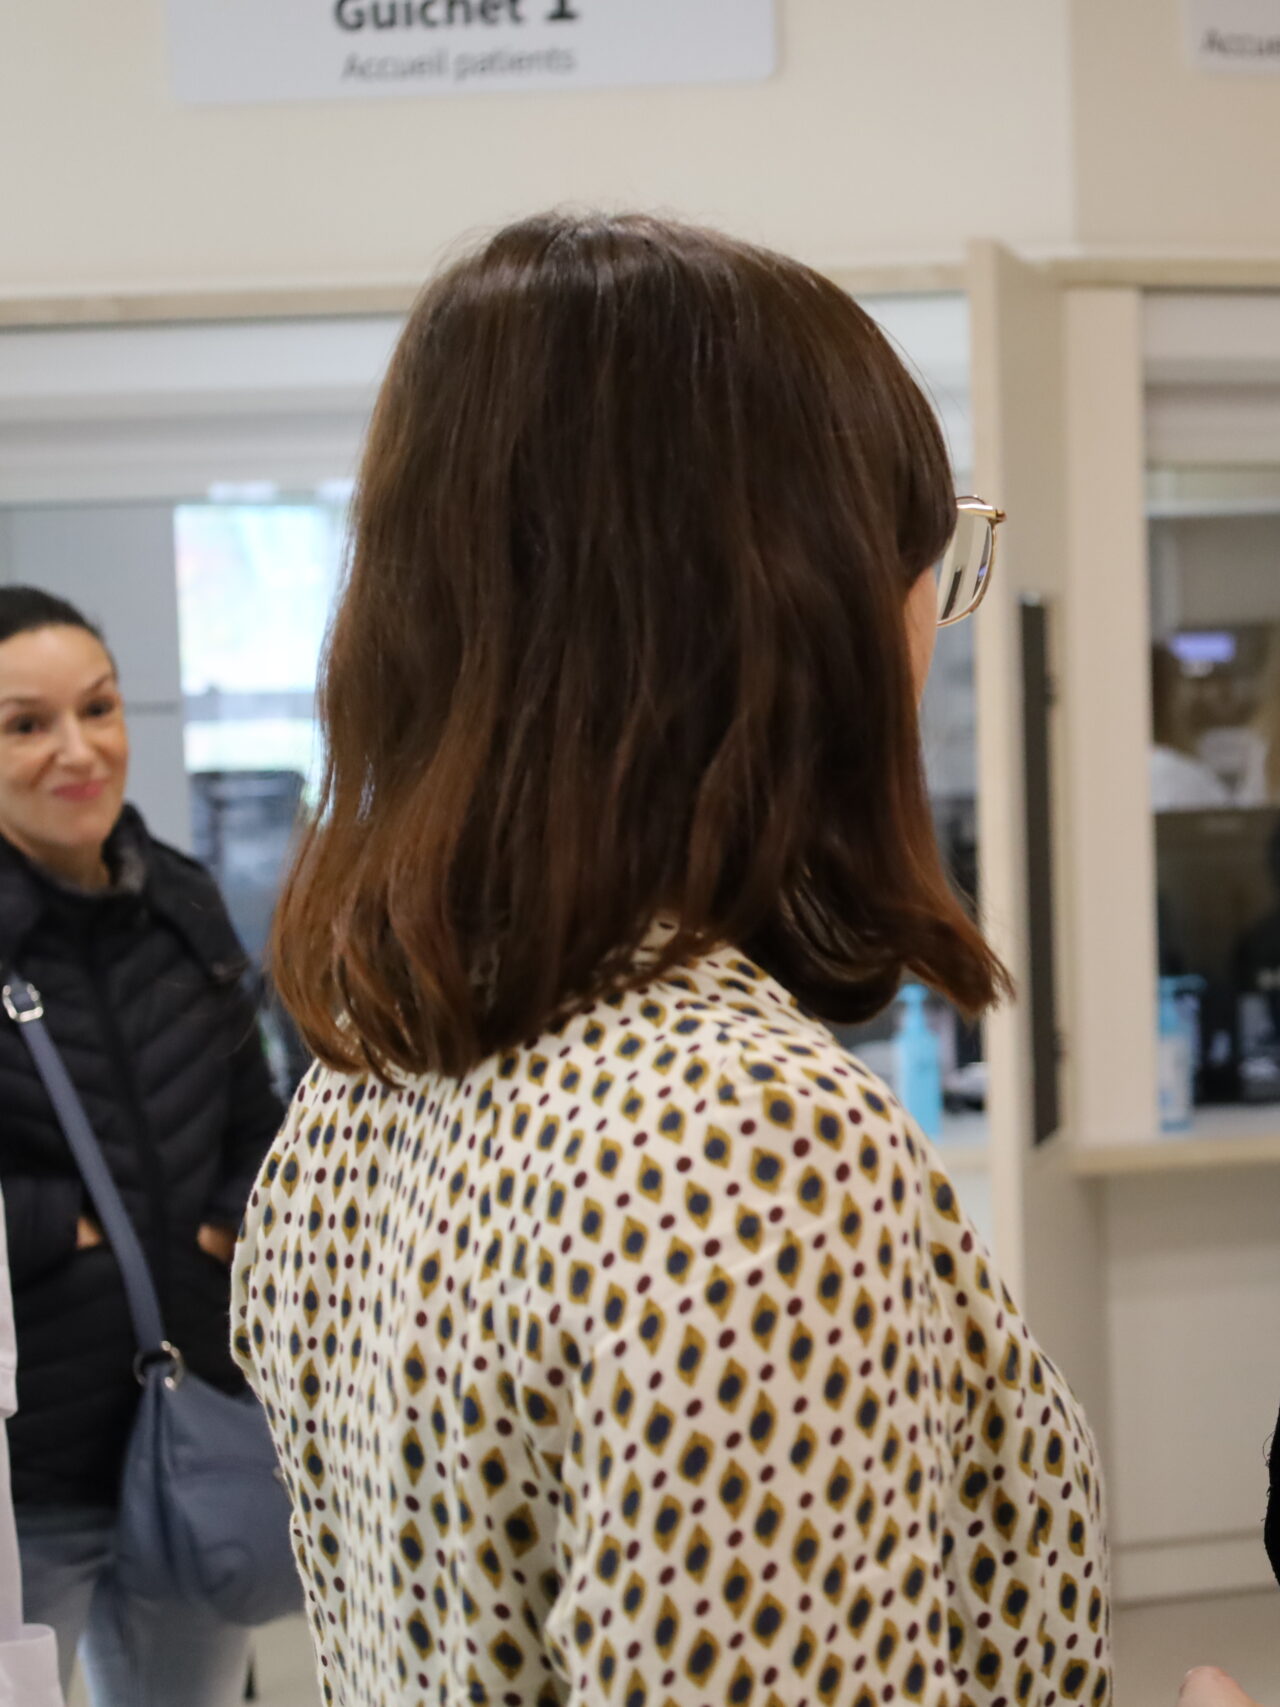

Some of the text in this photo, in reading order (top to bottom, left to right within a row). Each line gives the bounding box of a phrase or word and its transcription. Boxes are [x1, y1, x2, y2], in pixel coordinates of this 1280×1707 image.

[334, 0, 525, 31] Guichet
[340, 44, 577, 82] Accueil patients
